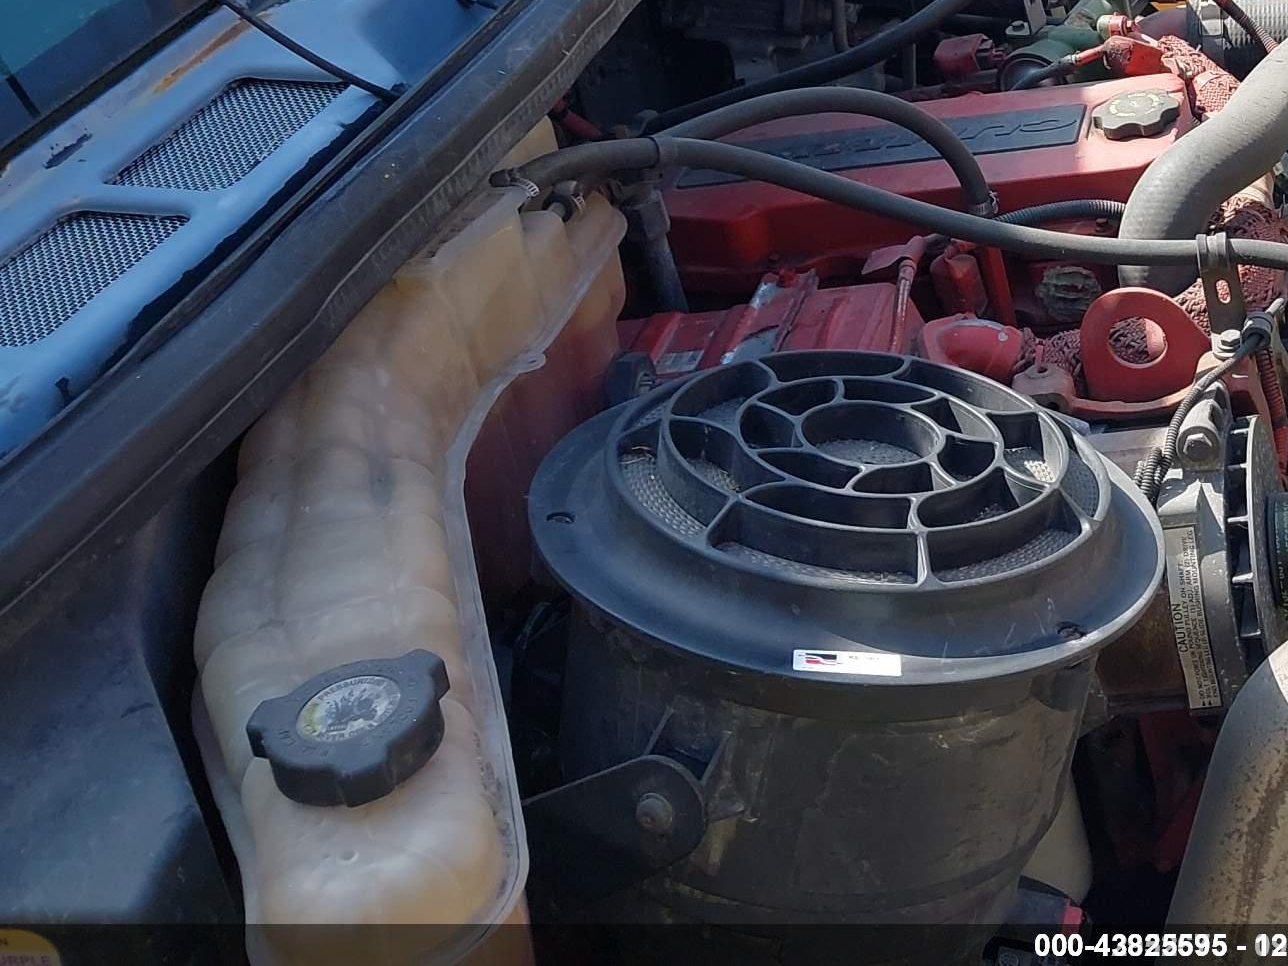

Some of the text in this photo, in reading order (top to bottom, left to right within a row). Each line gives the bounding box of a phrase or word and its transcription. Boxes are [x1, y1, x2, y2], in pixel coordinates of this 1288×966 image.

[1188, 545, 1199, 583] MOUNTING
[1180, 588, 1186, 598] ON
[1172, 603, 1188, 652] CAUTION
[1182, 601, 1191, 626] PULLEY
